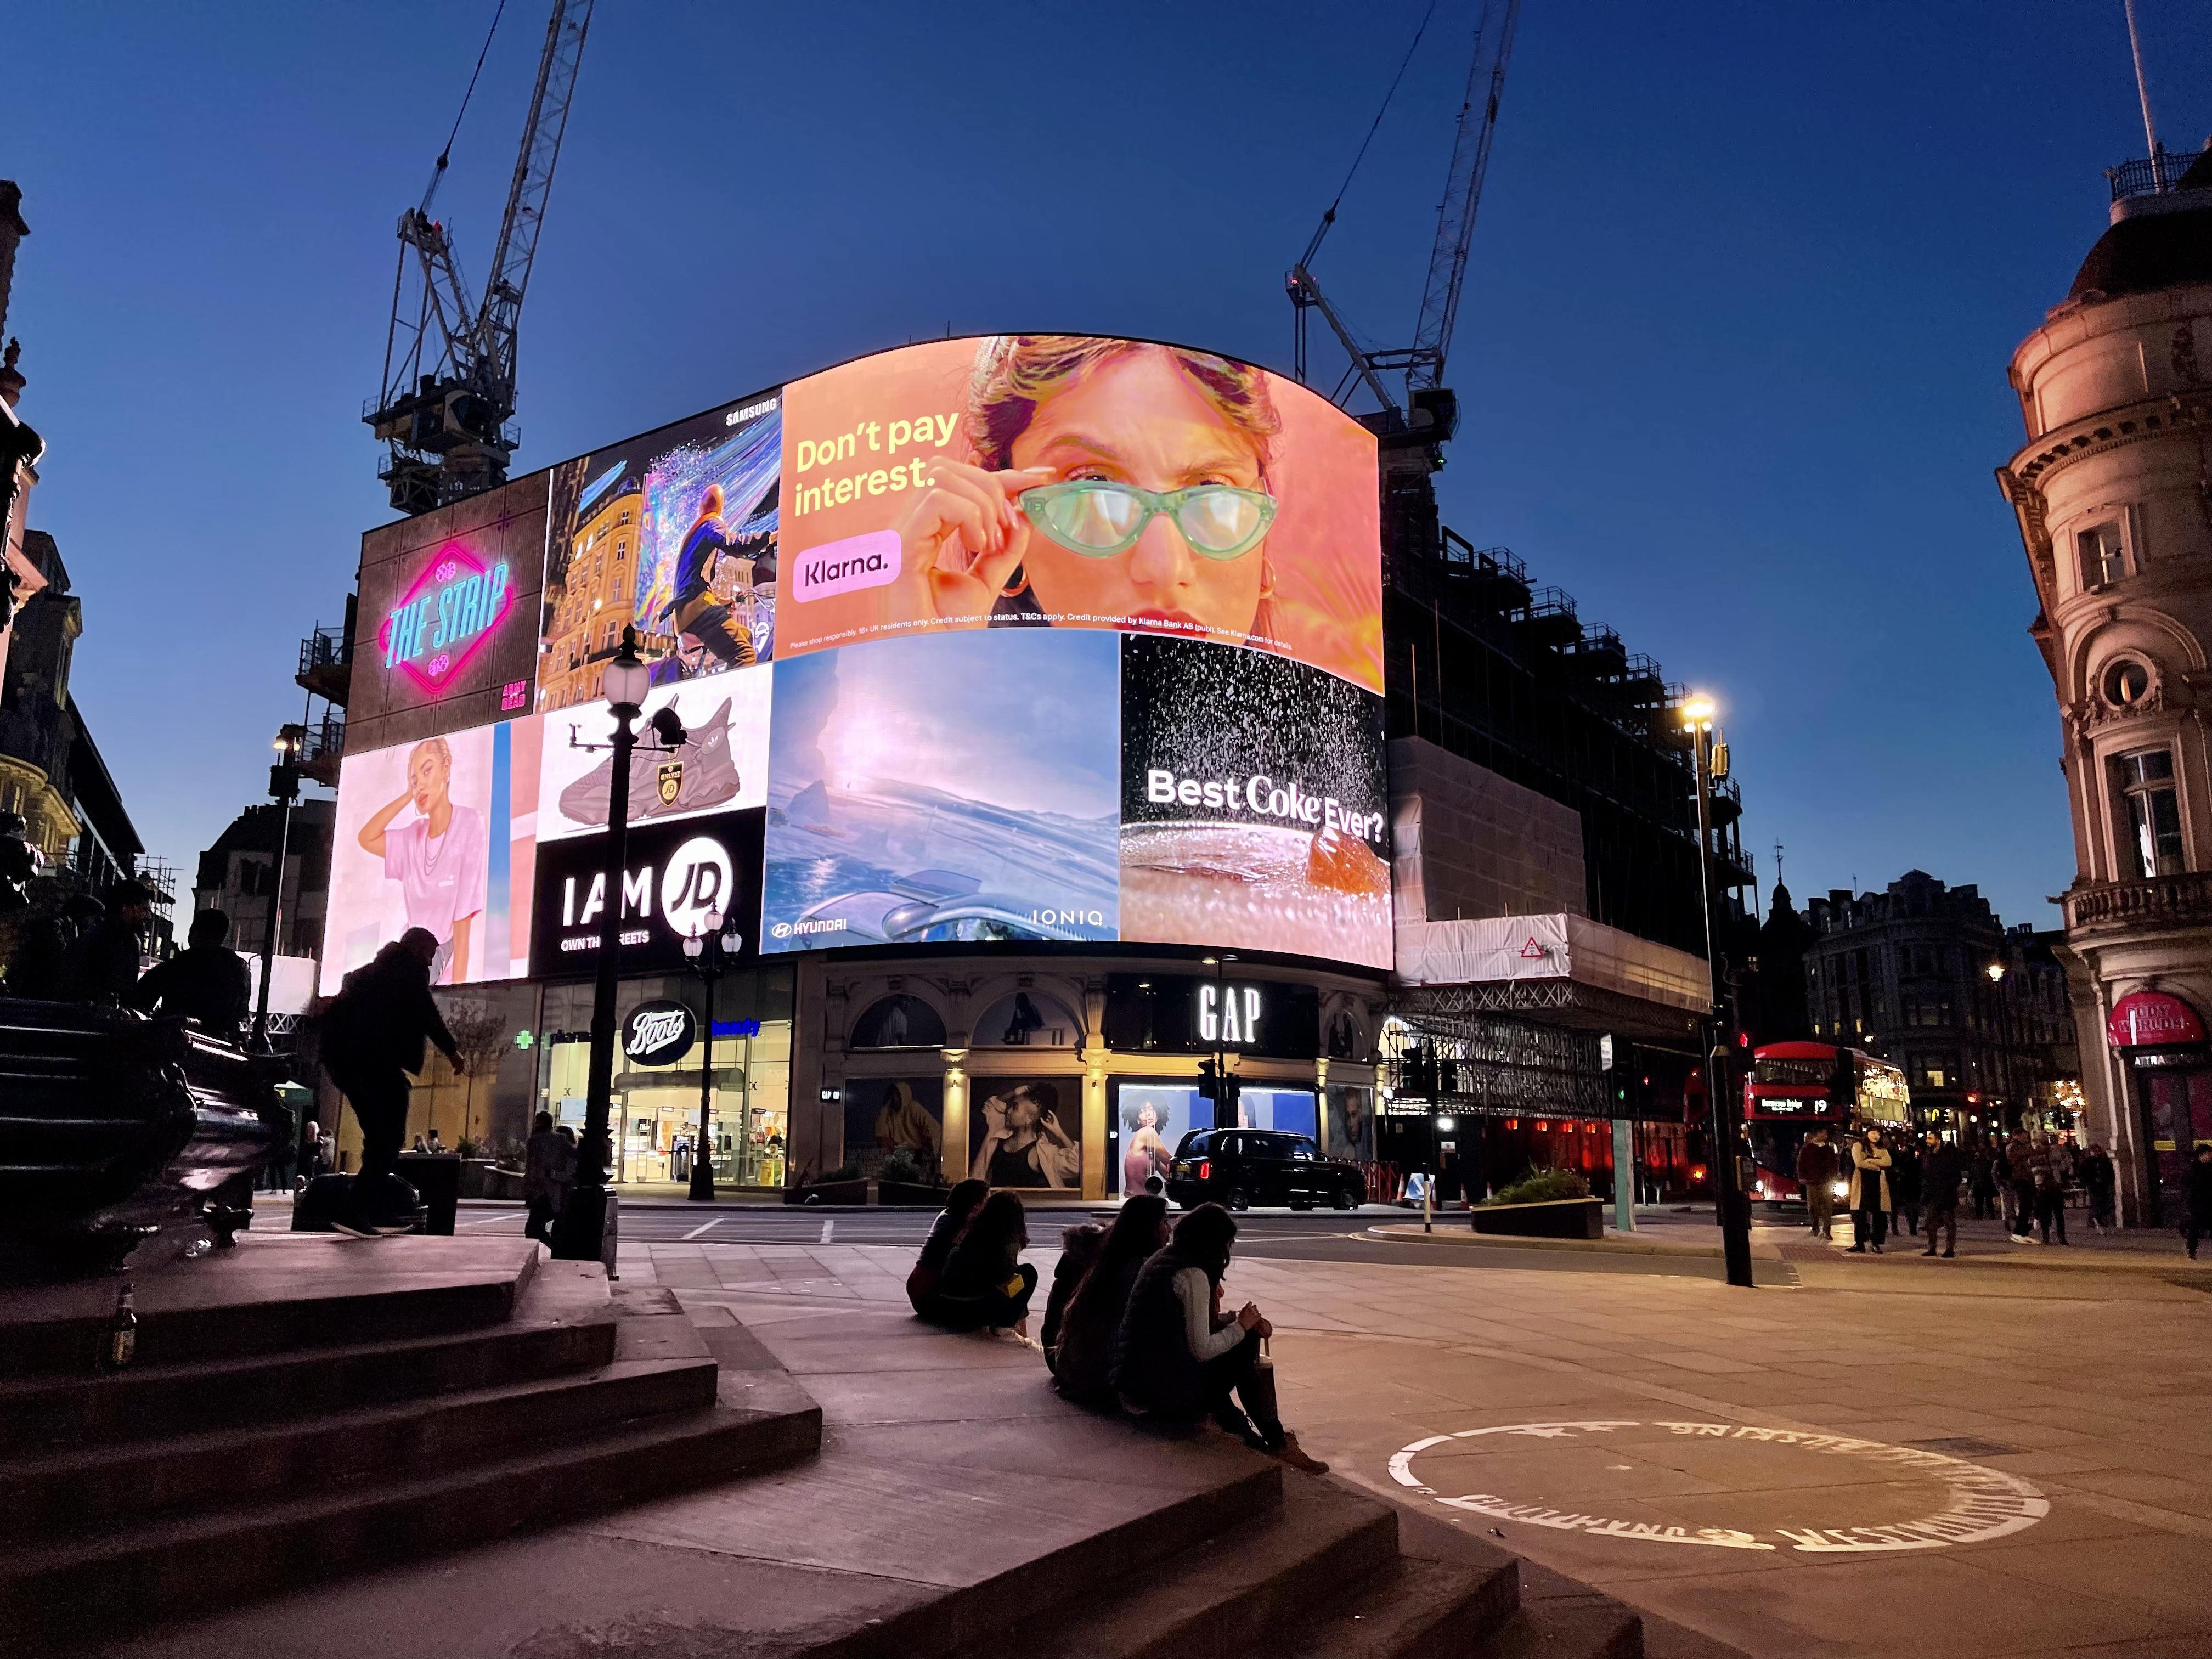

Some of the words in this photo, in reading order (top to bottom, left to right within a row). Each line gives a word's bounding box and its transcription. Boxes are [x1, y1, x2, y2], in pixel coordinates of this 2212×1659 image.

[725, 398, 777, 426] SAMSUNG
[797, 421, 881, 473] Don't
[888, 413, 960, 455] pay
[795, 457, 935, 517] interest.
[804, 553, 888, 587] Klarna.
[385, 596, 431, 669] THE
[432, 563, 509, 648] STRIP
[789, 640, 808, 649] Please
[809, 637, 822, 646] shop
[870, 624, 879, 633] UK
[881, 620, 911, 631] residents
[930, 616, 953, 625] Credit
[955, 614, 982, 624] subject
[1020, 612, 1041, 620] T&Cs
[1067, 613, 1091, 622] Credit
[1092, 614, 1126, 624] provided
[1127, 617, 1137, 625] by
[1138, 617, 1163, 627] Klarna
[1164, 620, 1181, 629] Bank
[1183, 622, 1193, 630] AB
[1217, 627, 1229, 636] See
[1231, 629, 1264, 643] Klarna.com
[1265, 636, 1273, 645] for
[501, 693, 526, 711] DEAD
[664, 785, 675, 794] JD
[1148, 769, 1240, 810] Best
[1246, 775, 1322, 824] Coke
[1324, 797, 1384, 843] Ever?
[562, 877, 577, 927] I
[670, 861, 722, 913] JD
[794, 918, 847, 935] HYUNDAI
[1032, 909, 1103, 927] IONIQ
[561, 938, 586, 952] OWN
[619, 930, 650, 945] REETS
[1199, 985, 1261, 1043] GAP
[626, 1009, 685, 1055] Boots
[1815, 1099, 1827, 1113] 19
